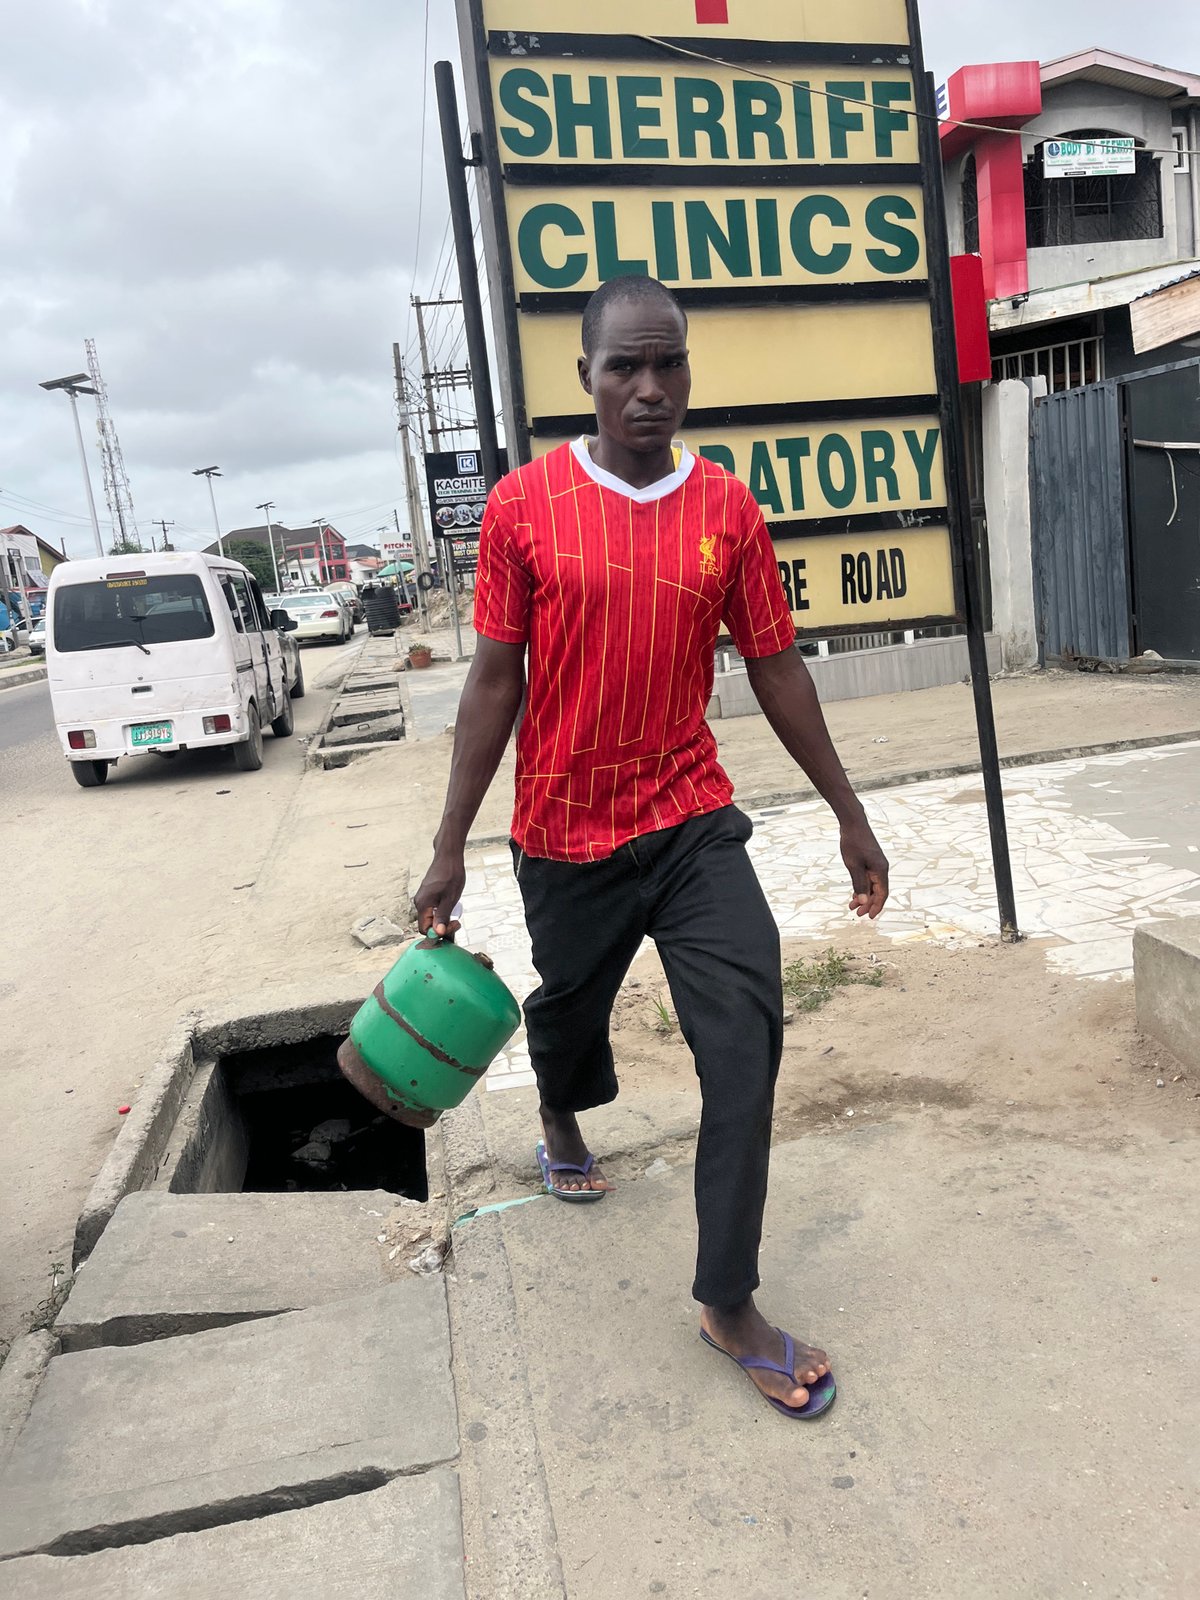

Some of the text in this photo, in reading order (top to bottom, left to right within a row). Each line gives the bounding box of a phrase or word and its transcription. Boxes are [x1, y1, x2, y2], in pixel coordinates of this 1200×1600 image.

[499, 68, 912, 160] SHERRIFF
[1060, 142, 1082, 156] BODY
[1086, 141, 1096, 155] BY
[518, 194, 920, 289] CLINICS
[436, 478, 485, 490] KACHITE
[841, 548, 907, 605] ROAD
